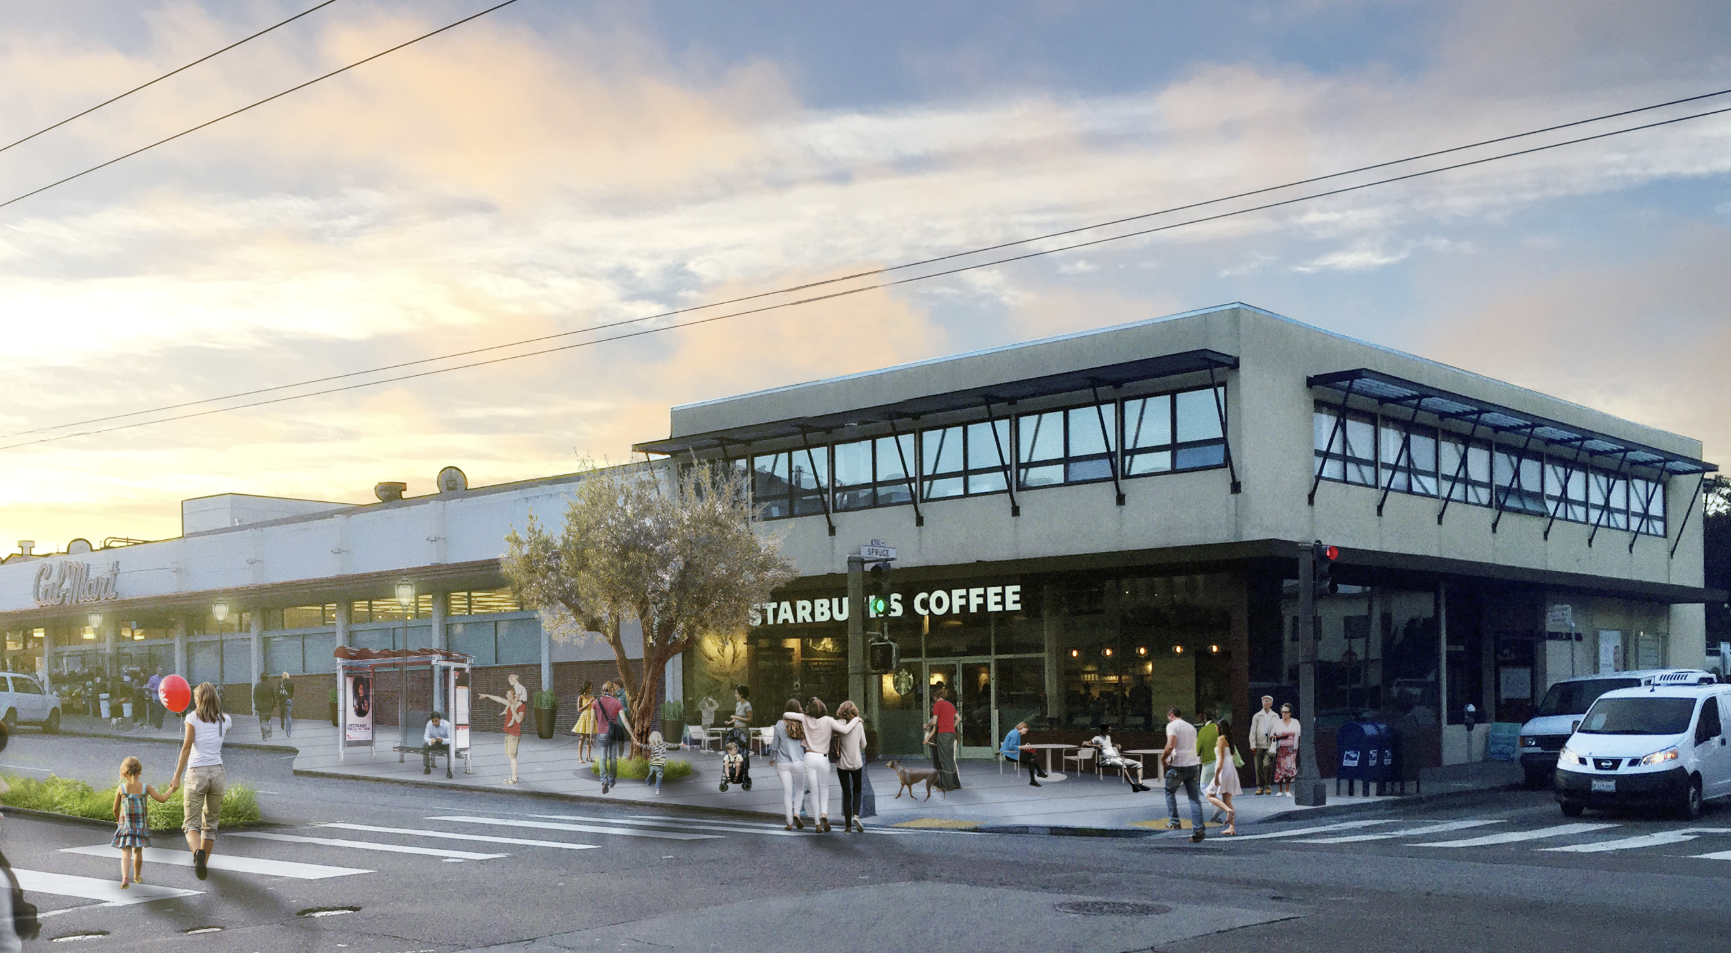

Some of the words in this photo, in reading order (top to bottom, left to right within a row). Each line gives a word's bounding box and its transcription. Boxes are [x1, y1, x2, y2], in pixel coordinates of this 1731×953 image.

[867, 547, 890, 557] SPRUCE
[748, 593, 904, 627] STARBUKS
[913, 585, 1021, 616] COFFEE
